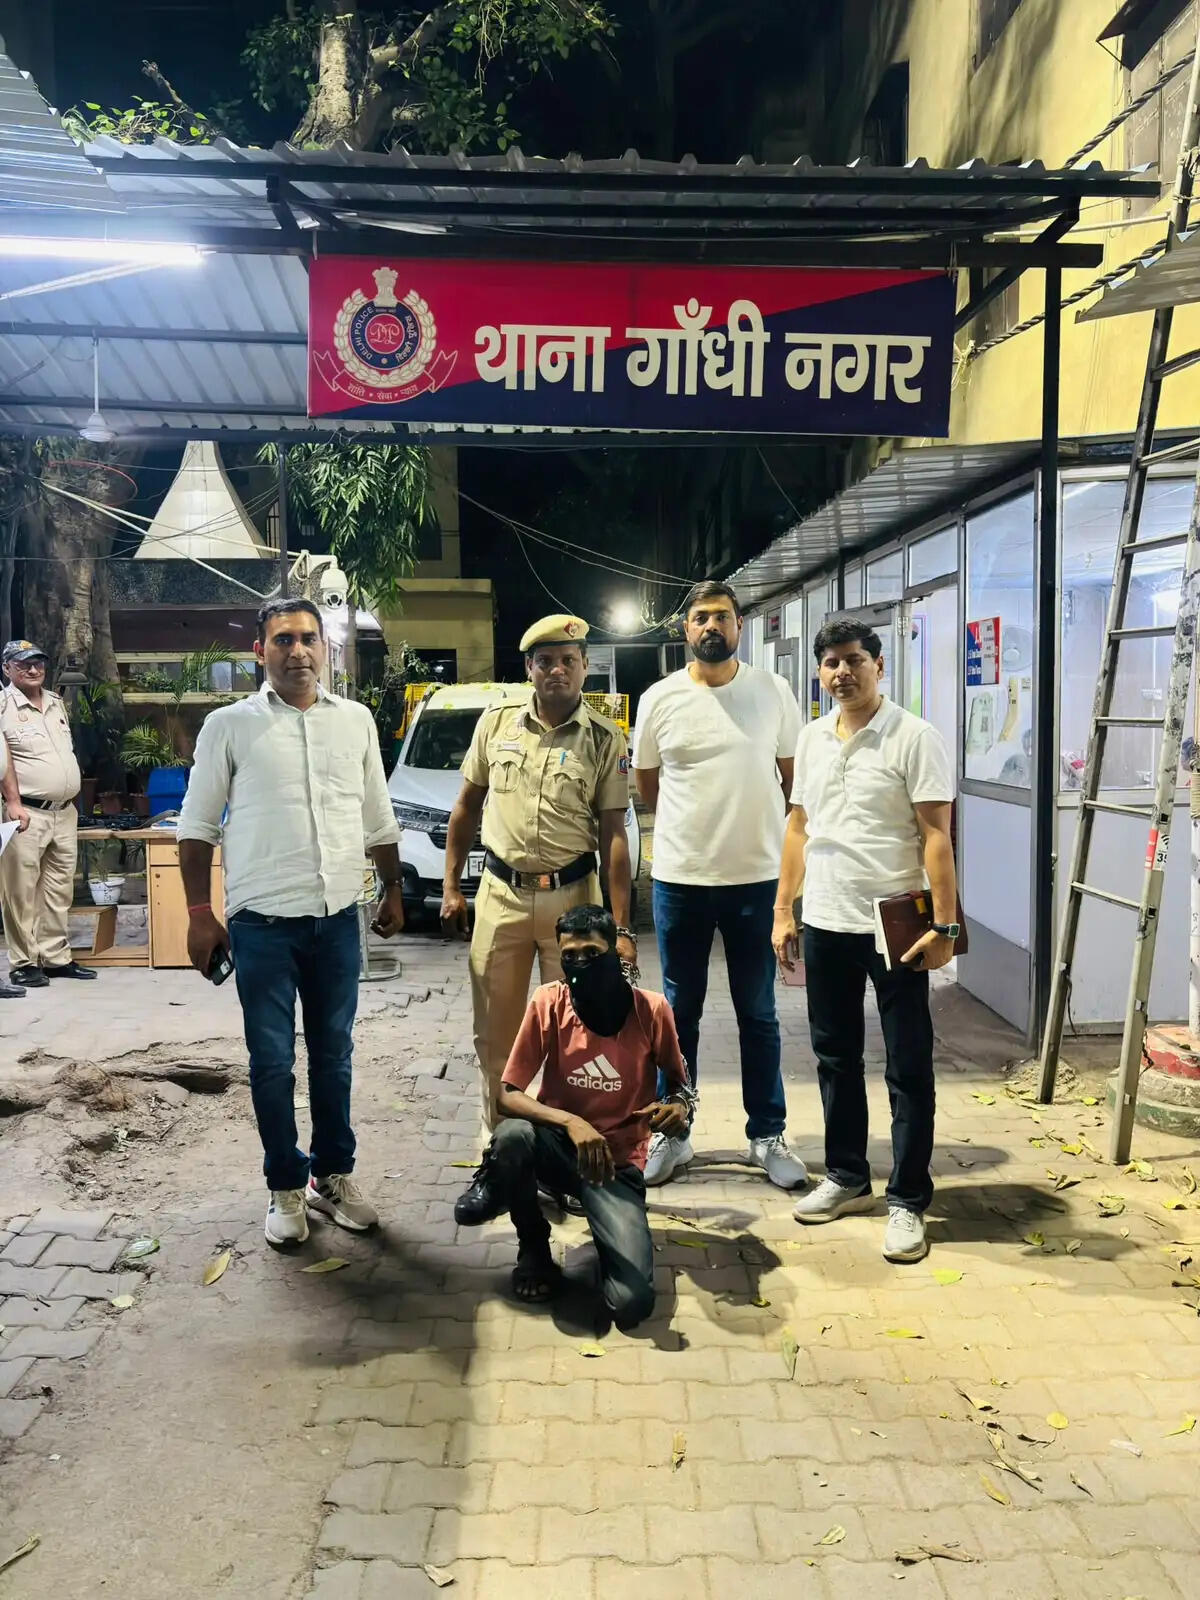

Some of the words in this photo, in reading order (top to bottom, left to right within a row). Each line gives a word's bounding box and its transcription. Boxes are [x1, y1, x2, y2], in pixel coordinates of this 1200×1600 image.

[354, 306, 374, 335] POLICE
[354, 336, 373, 360] DELHI
[474, 324, 611, 392] थाना
[625, 298, 771, 397] गाँधी
[785, 332, 932, 403] नगर
[566, 1075, 622, 1092] adidas
